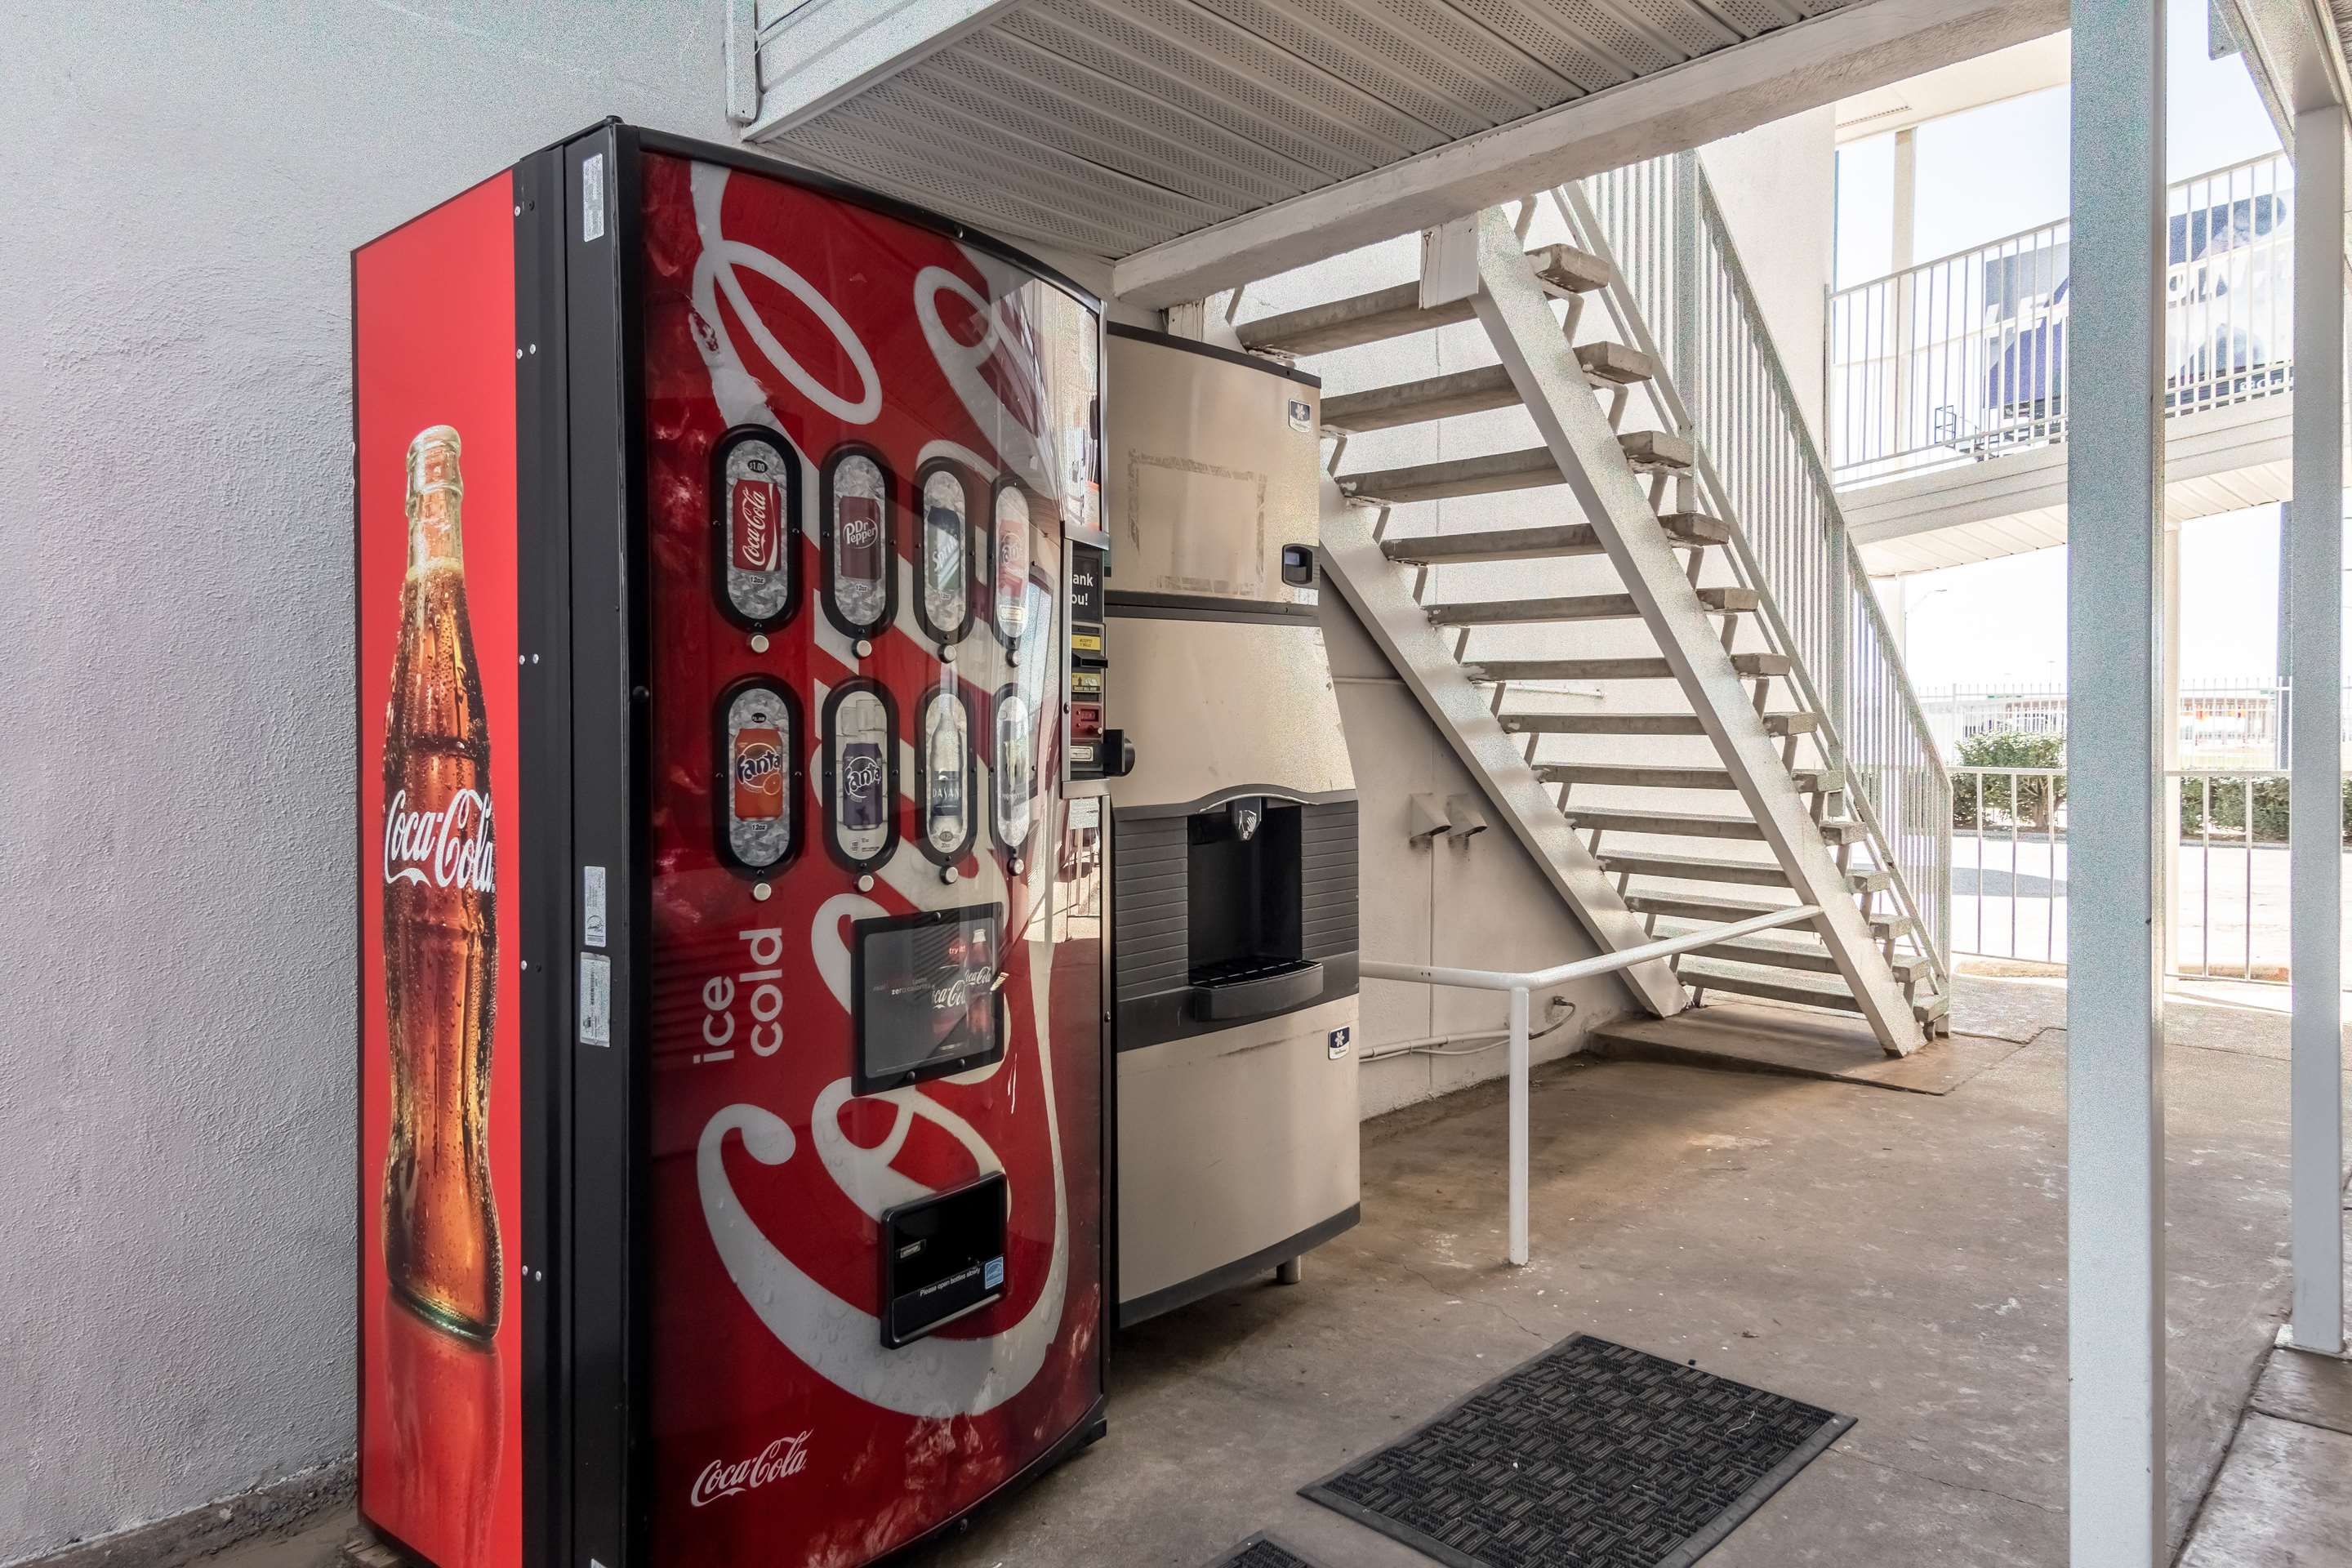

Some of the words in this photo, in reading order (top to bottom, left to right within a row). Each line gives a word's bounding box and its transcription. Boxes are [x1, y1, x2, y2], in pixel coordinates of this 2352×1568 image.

[749, 461, 766, 472] $1.00
[742, 486, 767, 567] Coca-Cola
[842, 523, 877, 546] Pepper
[854, 519, 869, 533] Dr
[1072, 573, 1094, 587] ank
[1071, 593, 1089, 606] ou!
[737, 750, 782, 785] Fanta
[932, 787, 962, 800] DASANI
[384, 787, 495, 894] Coca-Cola
[738, 927, 784, 1058] cold
[693, 976, 735, 1064] ice
[920, 1285, 938, 1297] Please
[938, 1280, 950, 1290] open
[950, 1273, 966, 1285] bottles
[691, 1428, 815, 1507] Coca-Cola
